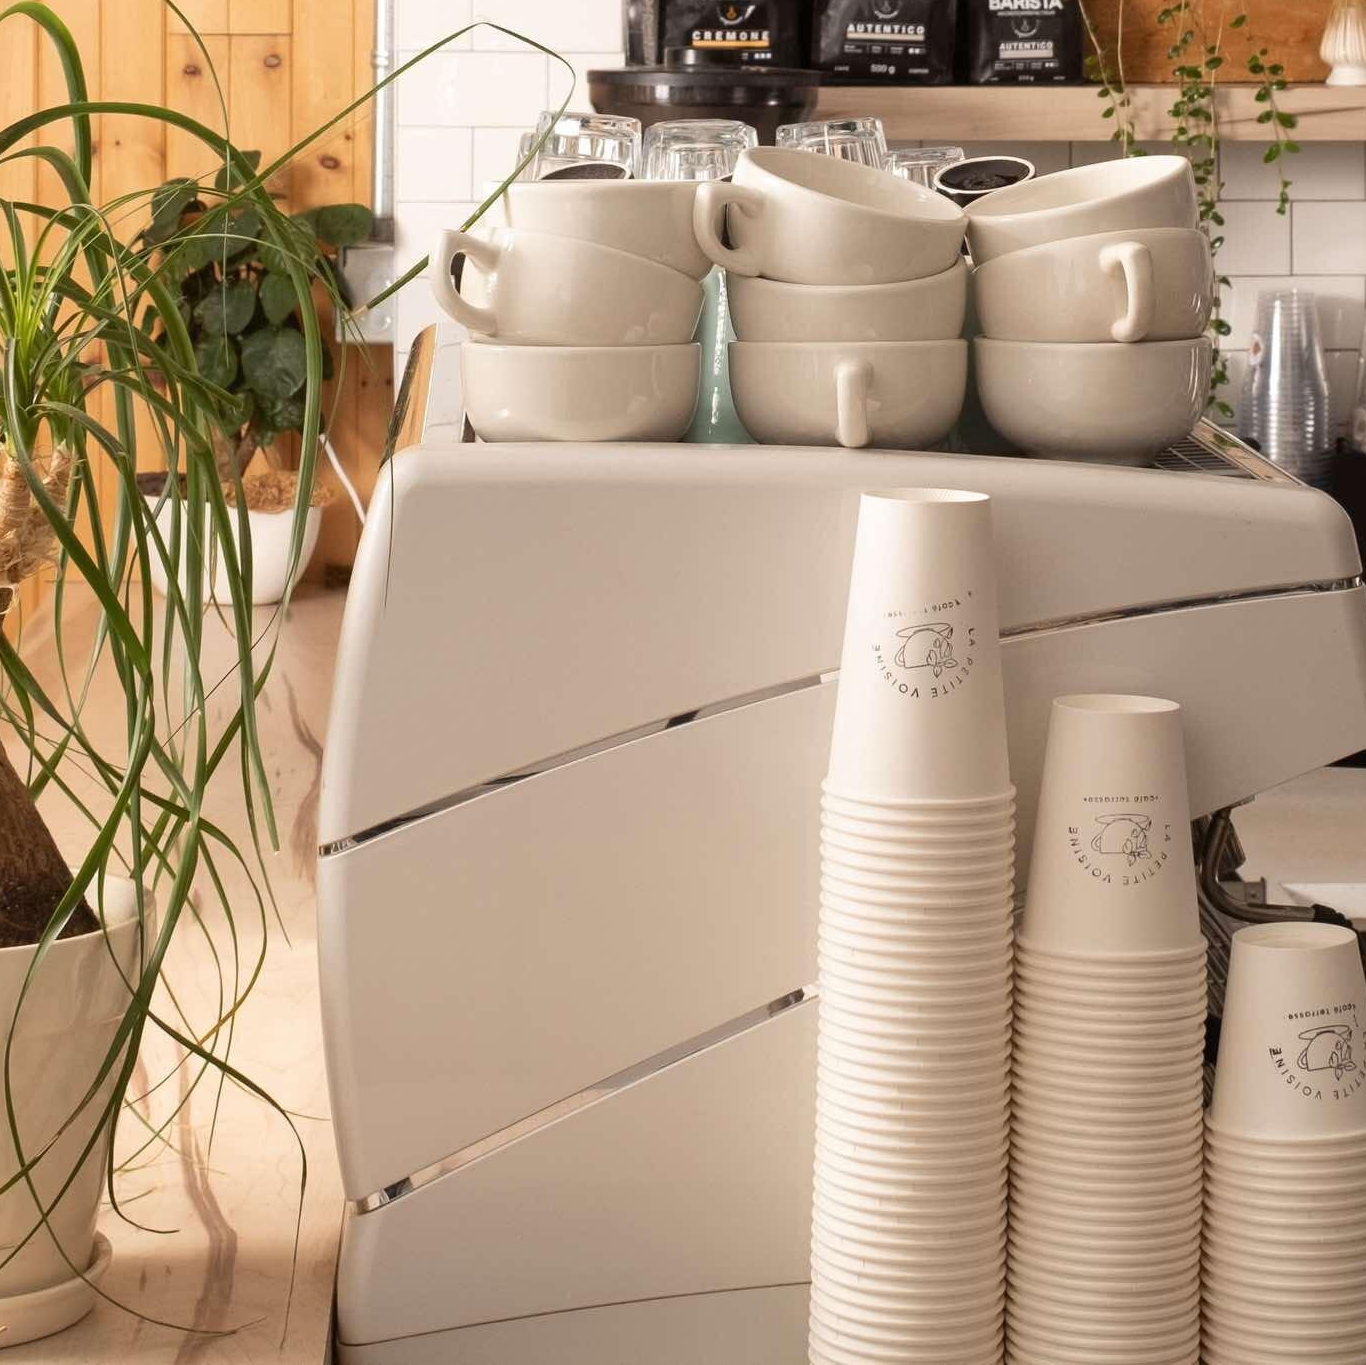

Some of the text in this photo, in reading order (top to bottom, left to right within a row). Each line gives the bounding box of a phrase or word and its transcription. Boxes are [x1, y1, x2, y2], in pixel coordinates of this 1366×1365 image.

[846, 23, 925, 35] AUTENTICO
[999, 40, 1054, 52] AUTENTICO
[872, 644, 920, 699] VOISINE
[930, 656, 975, 699] PETITE
[1068, 825, 1112, 885] VOISINE
[1122, 850, 1168, 886] PETITE
[1268, 1046, 1323, 1101] VOISINE
